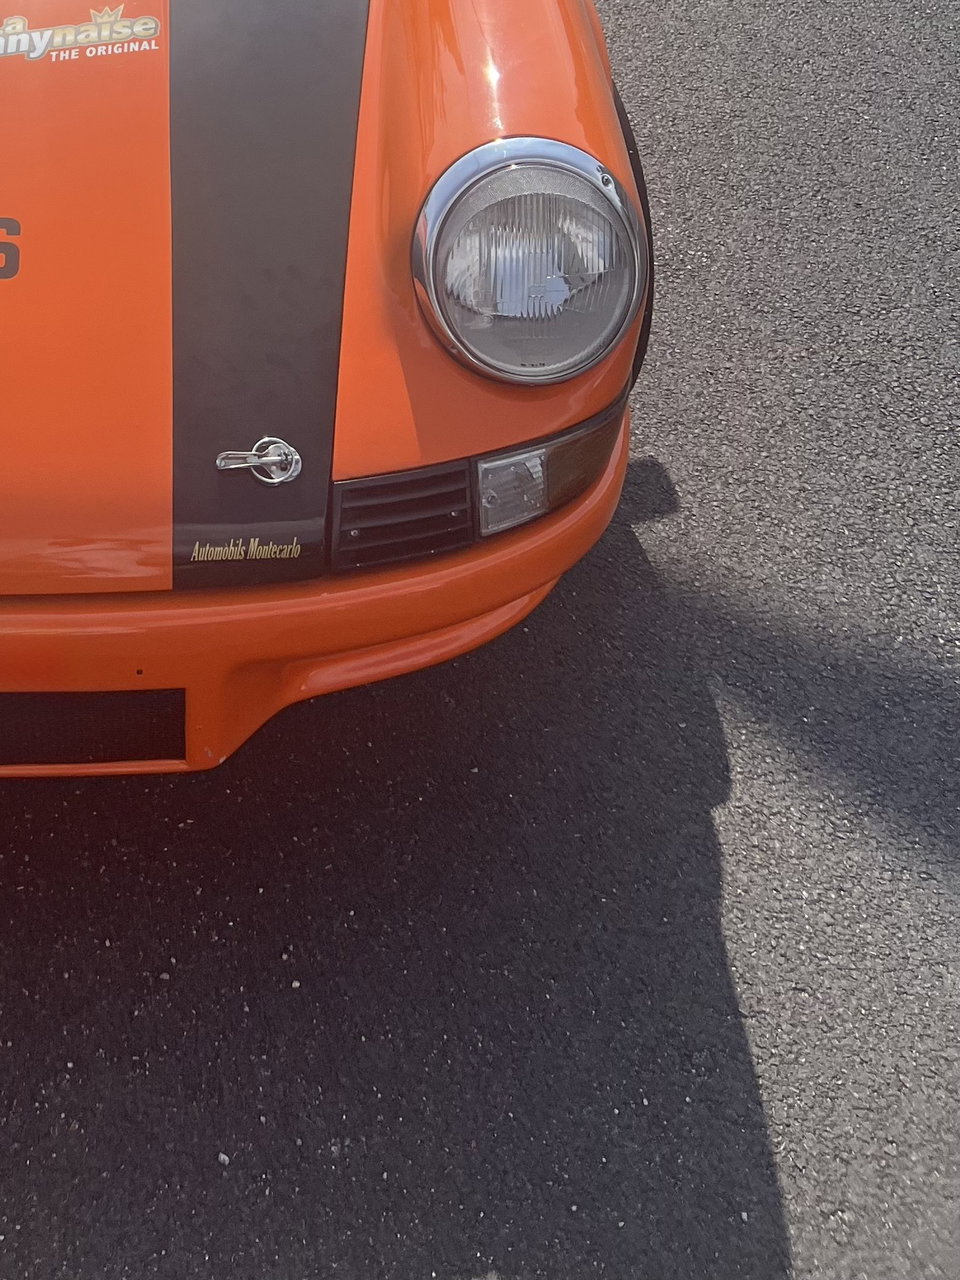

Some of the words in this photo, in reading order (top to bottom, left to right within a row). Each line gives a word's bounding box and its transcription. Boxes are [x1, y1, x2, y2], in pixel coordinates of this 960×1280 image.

[50, 50, 79, 63] THE
[85, 40, 160, 58] ORIGINAL
[247, 537, 301, 559] Montecarlo
